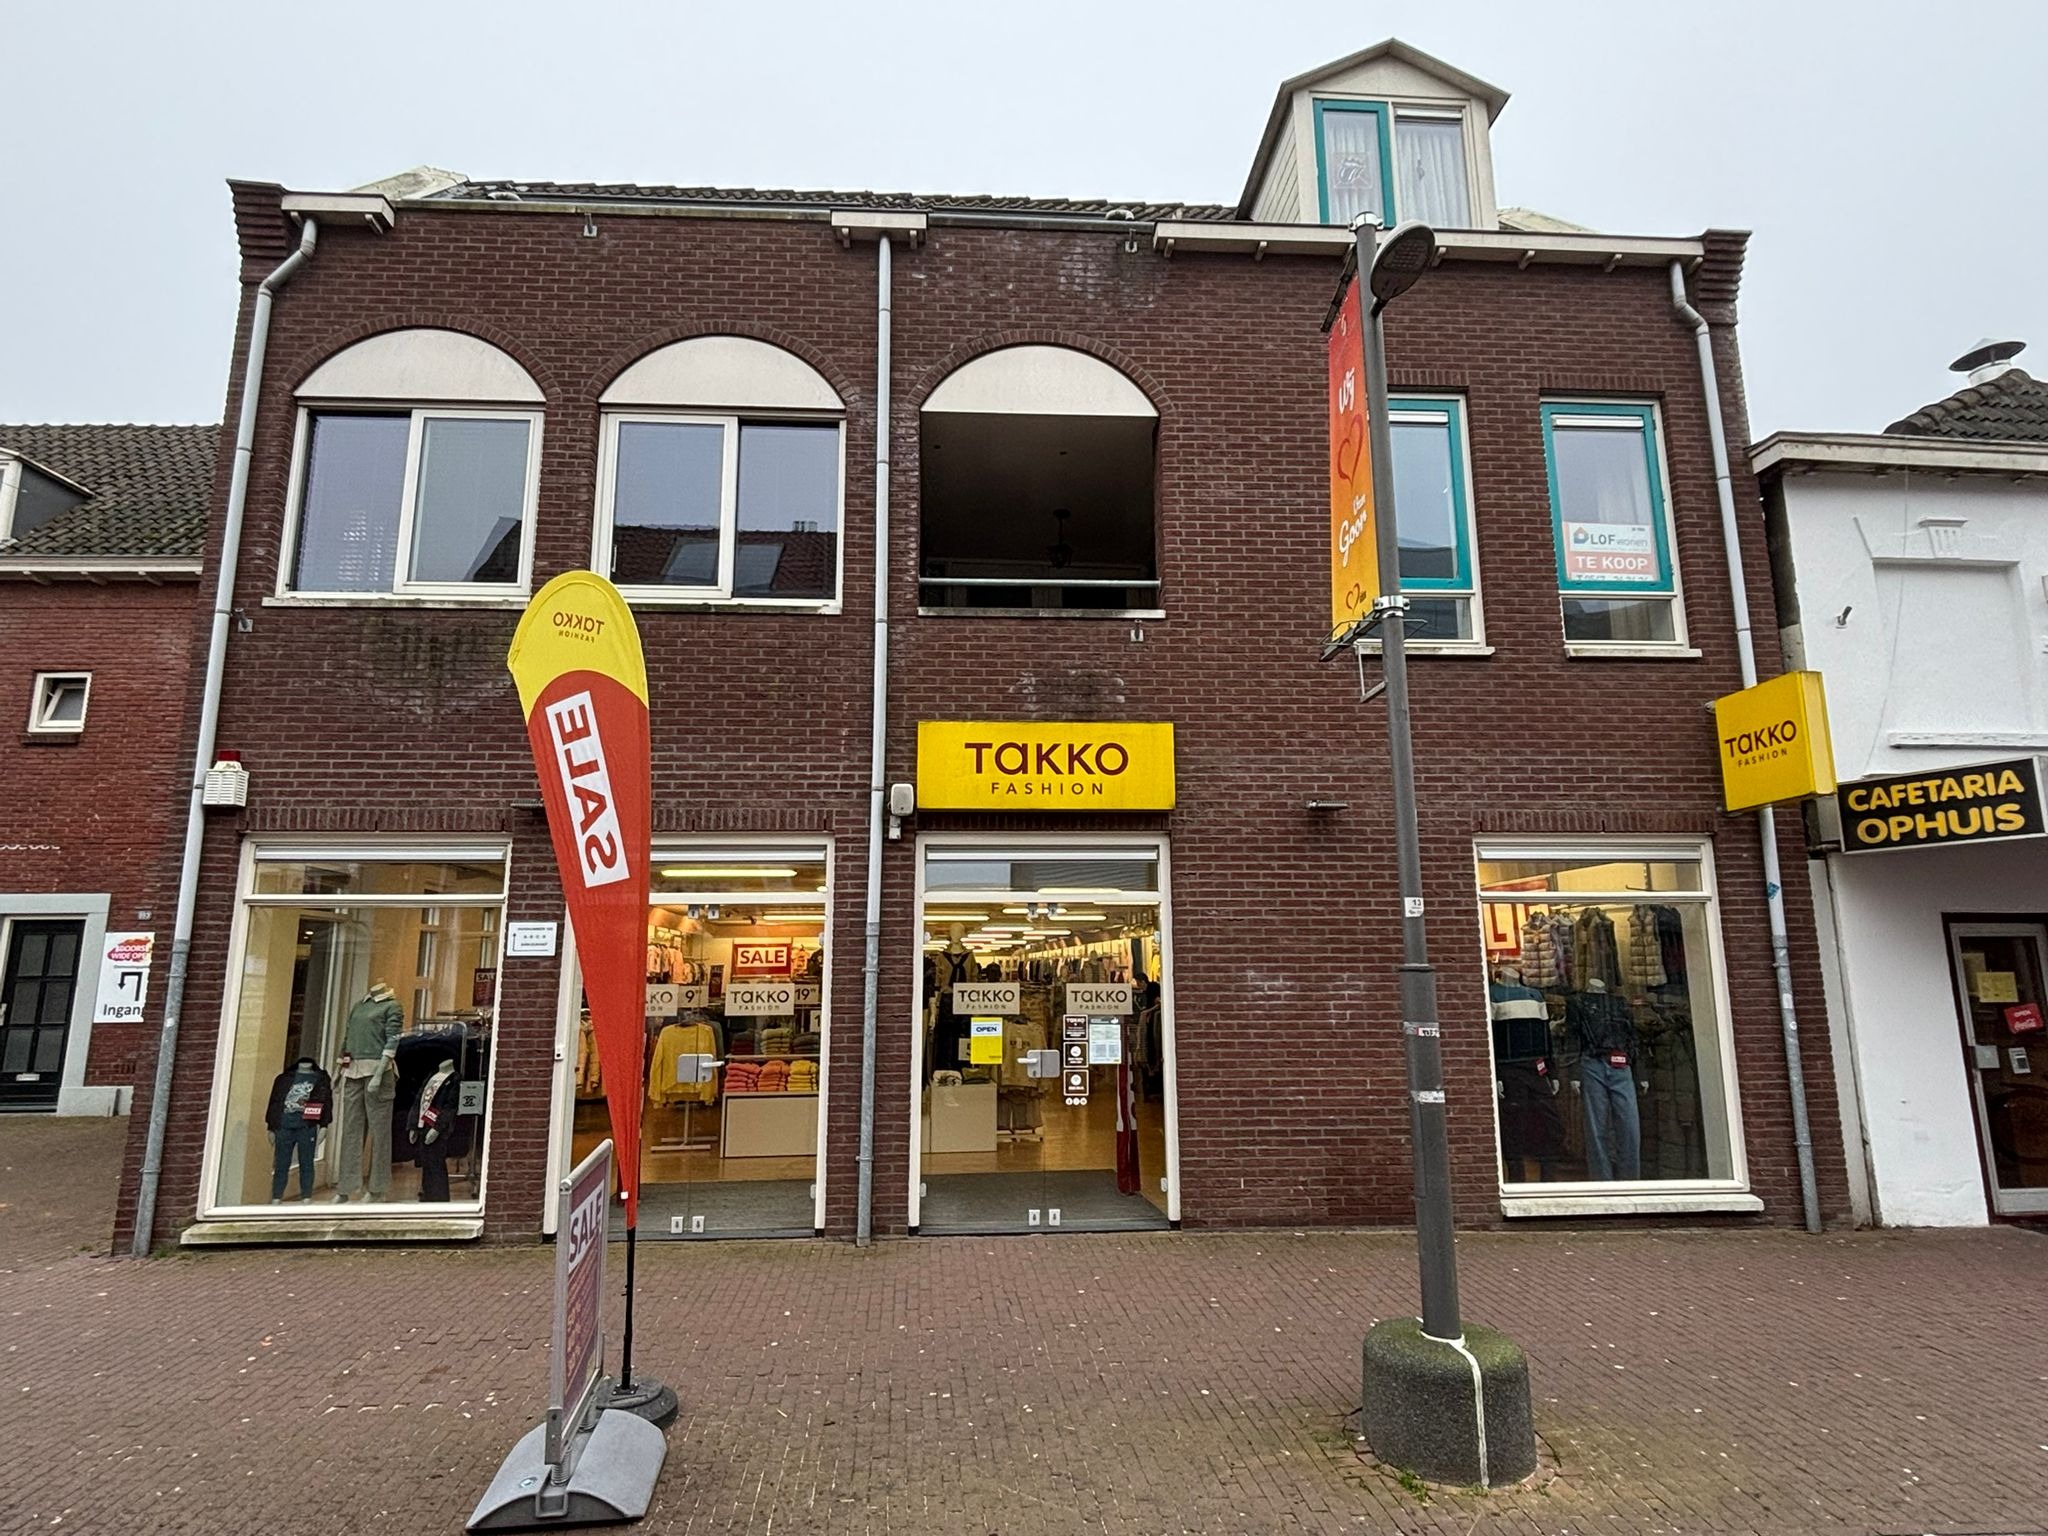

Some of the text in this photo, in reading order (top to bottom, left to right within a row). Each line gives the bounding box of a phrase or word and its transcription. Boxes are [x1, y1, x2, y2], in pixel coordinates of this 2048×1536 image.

[1590, 534, 1616, 545] LOF
[1576, 556, 1648, 571] TE KOOP
[1737, 748, 1788, 768] FASHION
[991, 782, 1104, 795] FASHION
[1848, 769, 2025, 812] CAFETARIA
[1856, 803, 2026, 844] OPHUIS
[740, 949, 785, 964] SALE
[103, 1003, 144, 1018] Ingan
[569, 1191, 603, 1263] SALE
